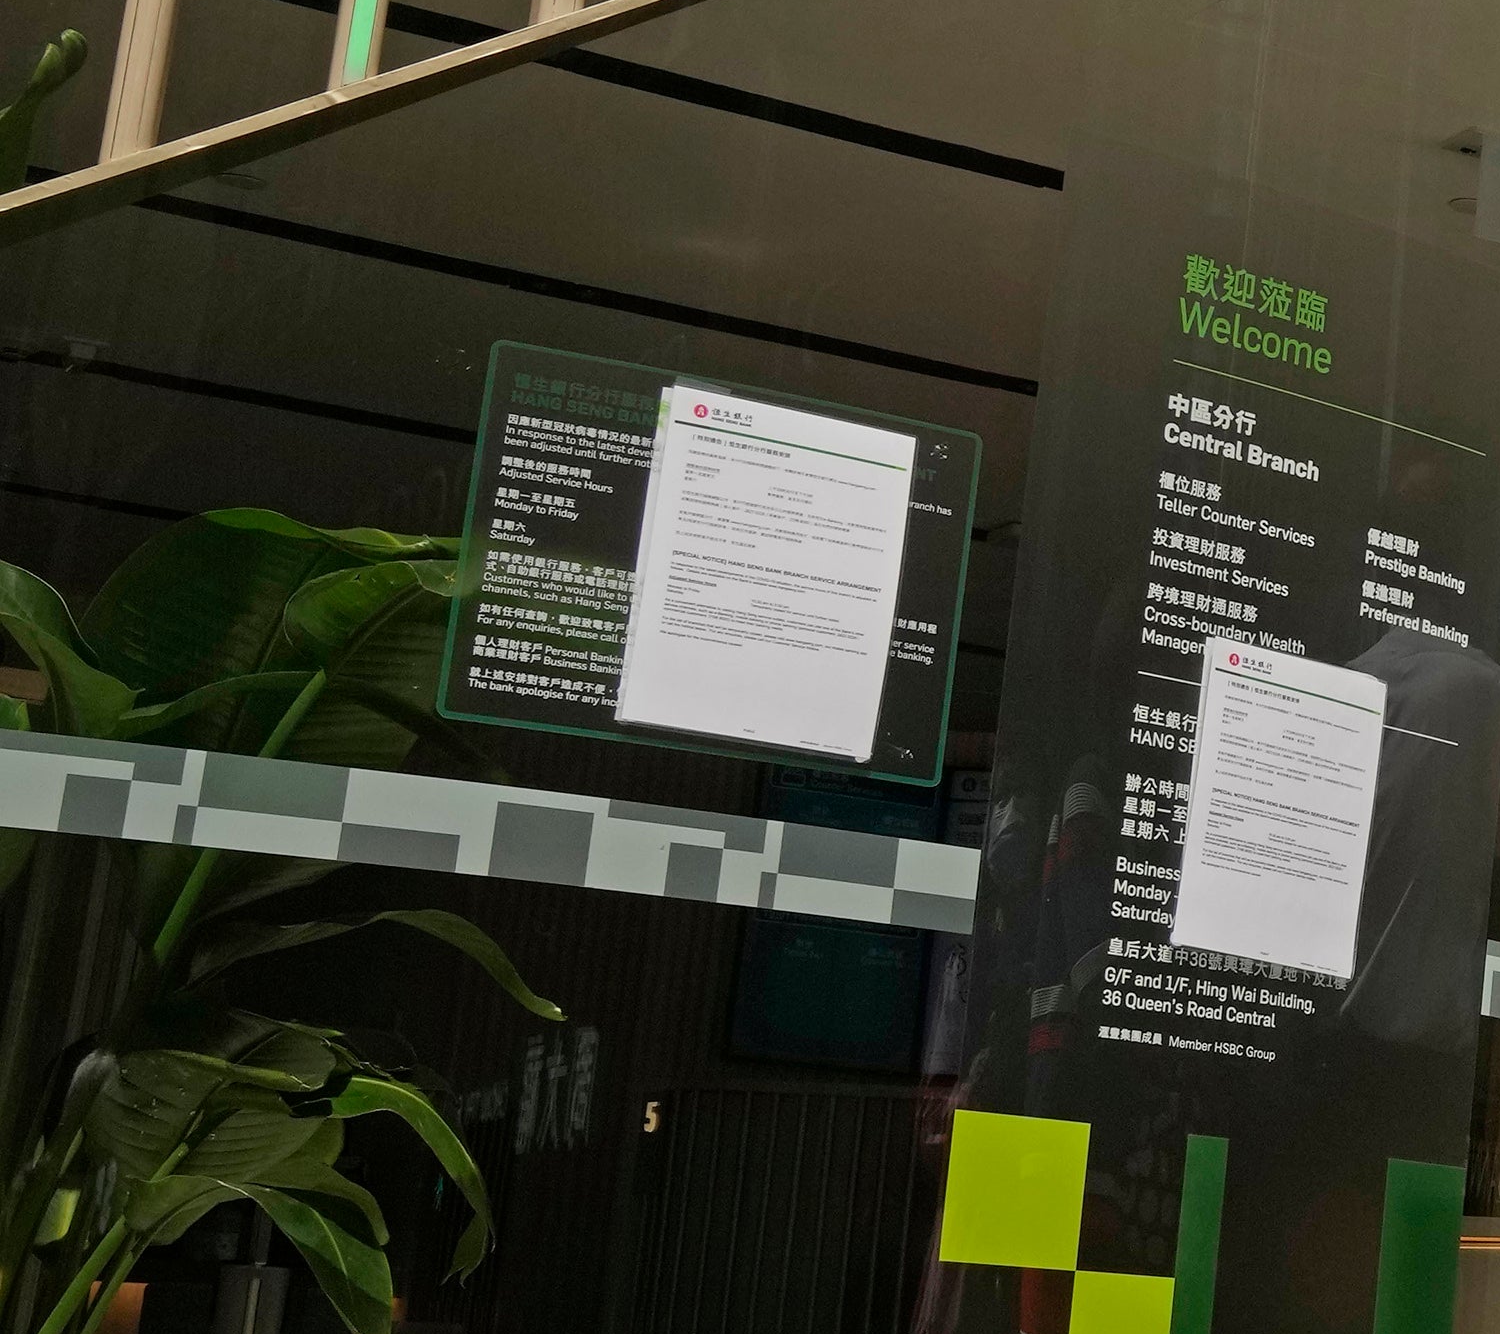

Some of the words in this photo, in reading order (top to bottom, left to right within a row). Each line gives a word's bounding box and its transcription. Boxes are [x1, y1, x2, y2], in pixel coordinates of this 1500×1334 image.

[1183, 254, 1328, 332] 歡迎蒞臨
[1179, 298, 1332, 374] Welcome
[1168, 393, 1256, 437] 中區分行
[503, 434, 529, 447] been
[529, 441, 573, 455] adjusted
[574, 448, 597, 459] until
[598, 450, 633, 465] further
[505, 424, 515, 434] In
[517, 428, 564, 443] response
[565, 435, 576, 445] to
[578, 437, 595, 448] the
[596, 440, 626, 454] latest
[1164, 423, 1243, 461] Central
[1247, 444, 1320, 482] Branch
[498, 466, 544, 482] Adjusted
[544, 473, 582, 488] Service
[583, 480, 613, 493] Hours
[1159, 471, 1222, 502] 櫃位服務
[494, 497, 534, 514] Monday
[535, 504, 546, 514] to
[547, 506, 579, 521] Friday
[909, 500, 935, 513] ranch
[937, 504, 952, 517] has
[1157, 494, 1198, 517] Teller
[1201, 505, 1256, 532] Counter
[1259, 520, 1315, 547] Services
[489, 529, 535, 546] Saturday
[491, 518, 526, 532] 星期六
[1153, 527, 1246, 565] 投資理財服務
[483, 571, 539, 588] Customers
[541, 581, 563, 592] who
[564, 585, 596, 597] would
[597, 588, 615, 600] like
[616, 592, 628, 602] to
[1150, 550, 1228, 583] Investment
[1232, 570, 1289, 597] Services
[1365, 549, 1416, 578] Prestige
[1418, 565, 1465, 594] Banking
[481, 582, 531, 599] channels,
[533, 591, 558, 602] such
[559, 595, 573, 604] as
[574, 596, 601, 610] Hang
[603, 600, 629, 614] Seng
[1147, 582, 1258, 623] 跨境理財通服務
[476, 613, 495, 624] For
[495, 618, 515, 629] any
[515, 621, 564, 636] enquiries,
[565, 627, 598, 640] please
[599, 633, 618, 643] call
[894, 617, 937, 635] 財應用程
[1144, 606, 1257, 645] Cross-boundary
[1259, 631, 1306, 655] Wealth
[1360, 602, 1420, 631] Preferred
[1422, 619, 1469, 648] Banking
[544, 644, 588, 660] Personal
[589, 651, 623, 665] Bankin
[897, 649, 933, 665] banking.
[904, 641, 935, 654] service
[543, 655, 587, 671] Business
[589, 662, 622, 676] Bankin
[468, 677, 488, 689] The
[488, 680, 514, 693] bank
[515, 686, 564, 699] apologise
[565, 690, 580, 701] for
[581, 695, 600, 706] any
[1130, 728, 1175, 750] HANG
[1178, 738, 1197, 755] SE
[1125, 773, 1190, 801] 辦公時間
[1120, 818, 1169, 842] 星期六
[1116, 856, 1181, 881] Business
[1113, 879, 1171, 905] Monday
[1111, 901, 1175, 928] Saturday
[1104, 967, 1132, 986] G/F
[1135, 973, 1162, 990] and
[1165, 975, 1192, 996] 1/F,
[1196, 980, 1227, 1001] Hing
[1231, 985, 1256, 1003] Wai
[1259, 988, 1316, 1014] Building,
[1102, 989, 1121, 1006] 36
[1125, 992, 1183, 1015] Queen's
[1187, 1001, 1223, 1020] Road
[1226, 1006, 1276, 1028] Central
[1168, 1035, 1212, 1053] Member
[1214, 1042, 1243, 1057] HSBC
[1246, 1046, 1276, 1062] Group
[643, 1101, 661, 1133] 5
